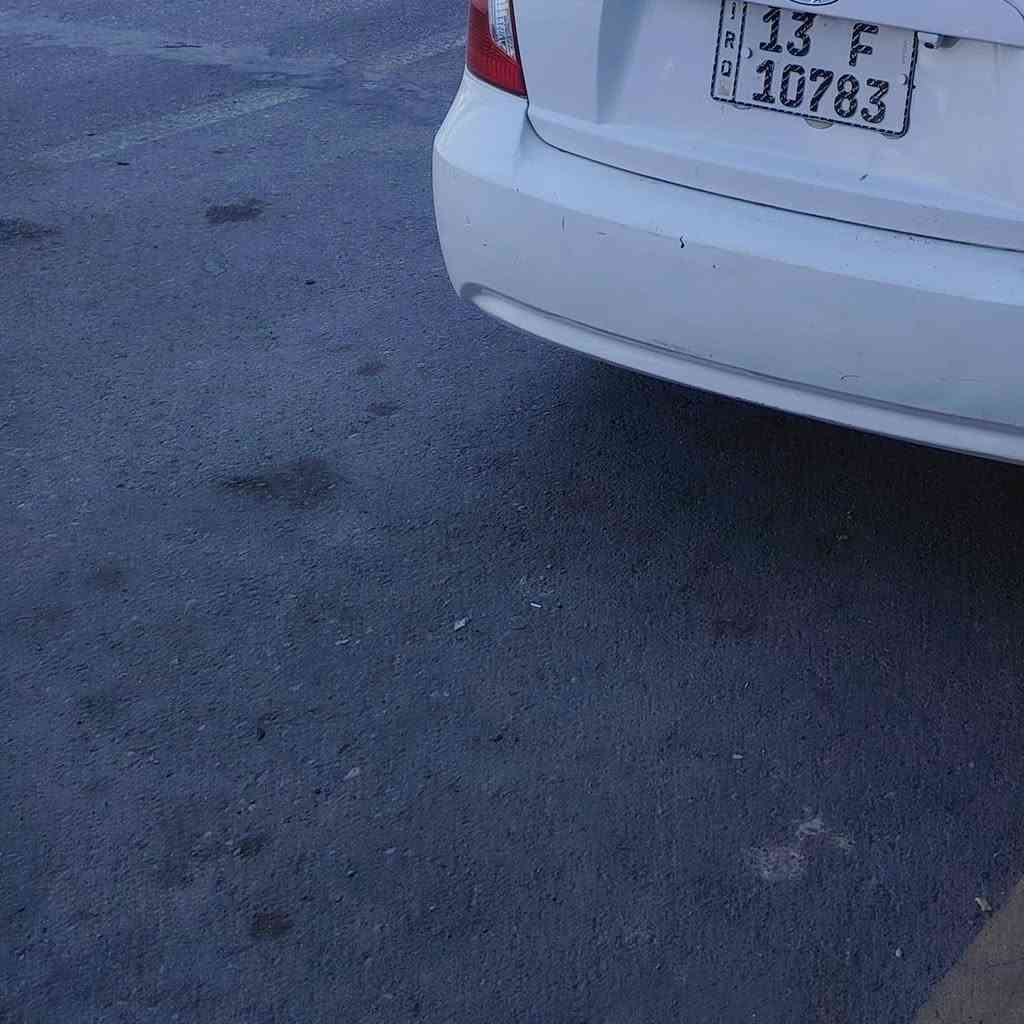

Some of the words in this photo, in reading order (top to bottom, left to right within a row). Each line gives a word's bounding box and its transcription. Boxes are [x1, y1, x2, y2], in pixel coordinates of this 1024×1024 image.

[758, 6, 817, 58] 13
[848, 22, 879, 67] F
[752, 59, 890, 125] 10783
